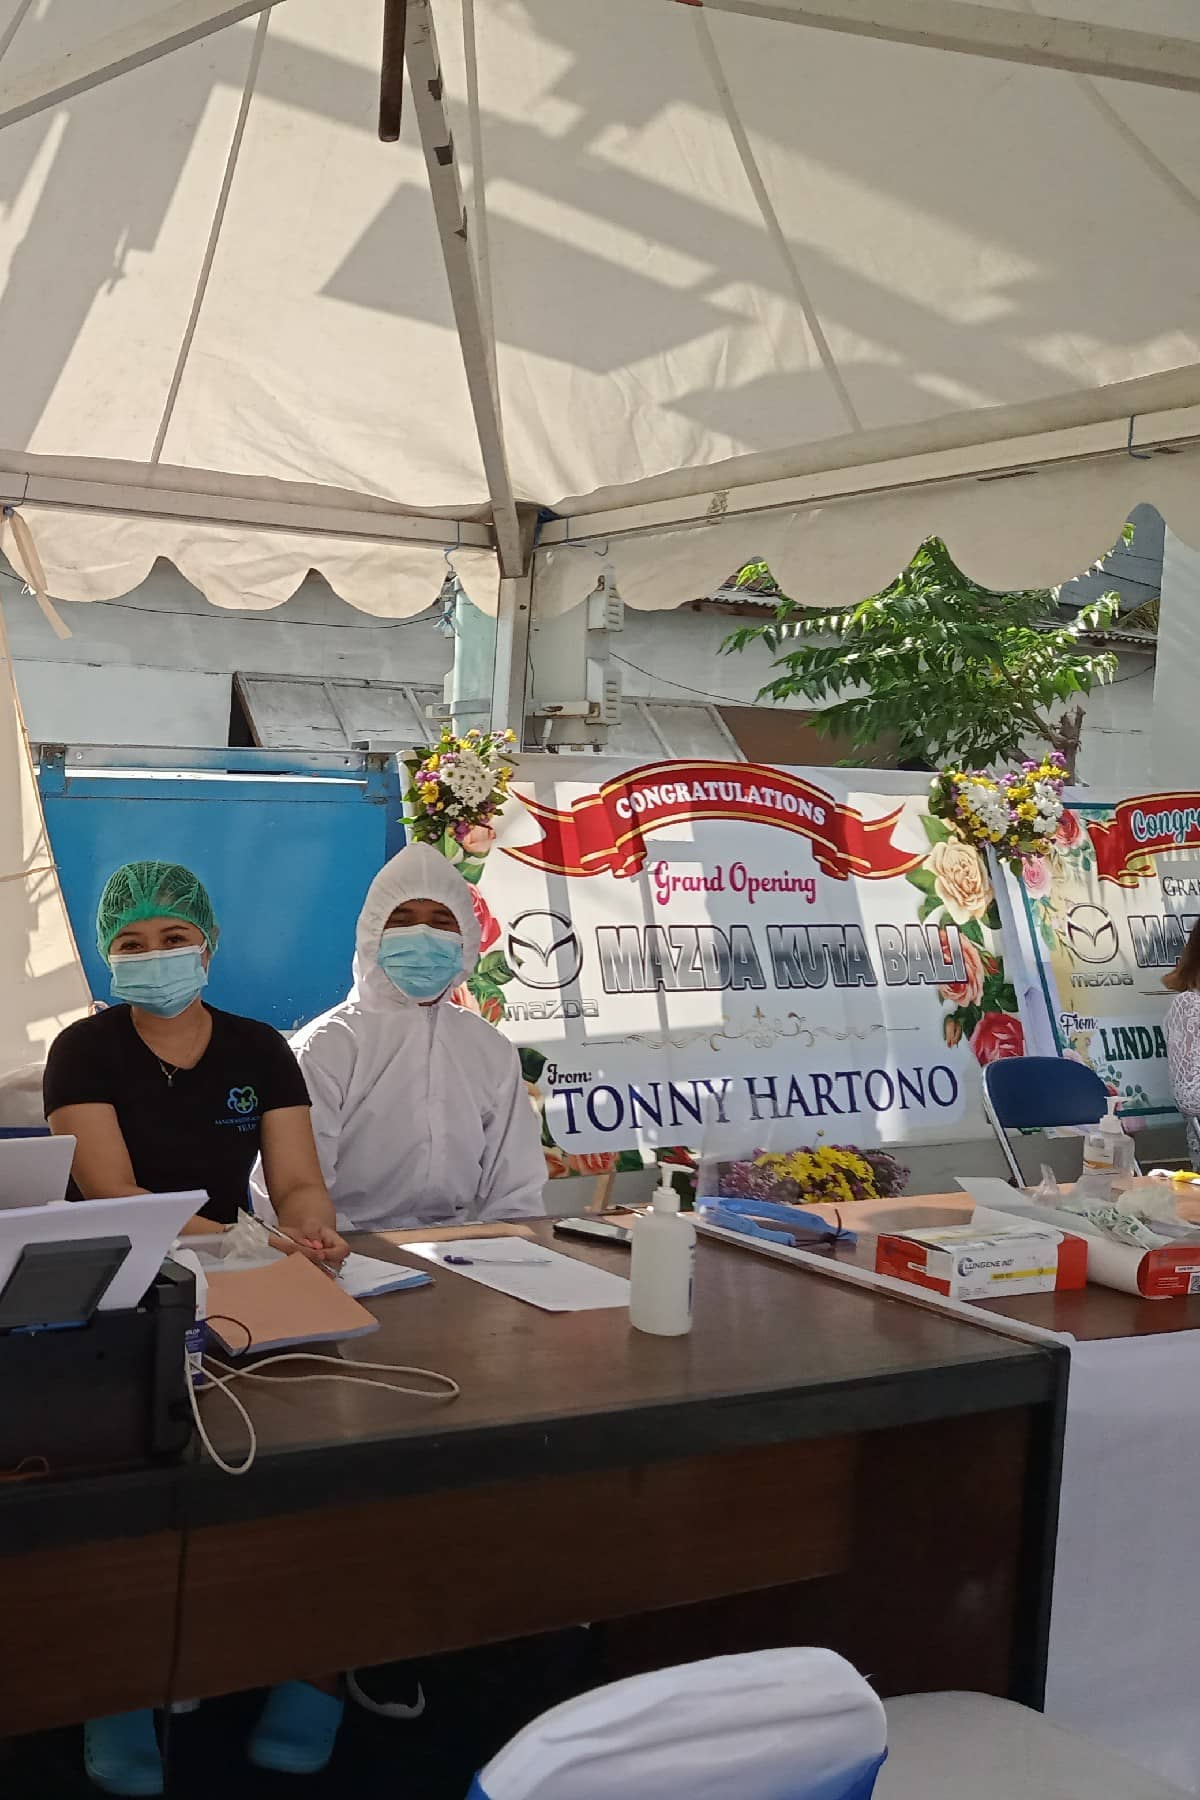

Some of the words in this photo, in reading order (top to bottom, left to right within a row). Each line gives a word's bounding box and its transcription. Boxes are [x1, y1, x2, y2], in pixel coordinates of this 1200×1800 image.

[615, 781, 827, 827] CONGRATULATIONS
[653, 860, 724, 906] Grand
[729, 861, 816, 904] Opening
[596, 924, 765, 993] MAZDA
[765, 924, 878, 988] KUTA
[876, 923, 970, 985] BALI
[547, 1063, 593, 1086] From:
[552, 1078, 734, 1137] TONNY
[744, 1064, 960, 1123] HARTONO
